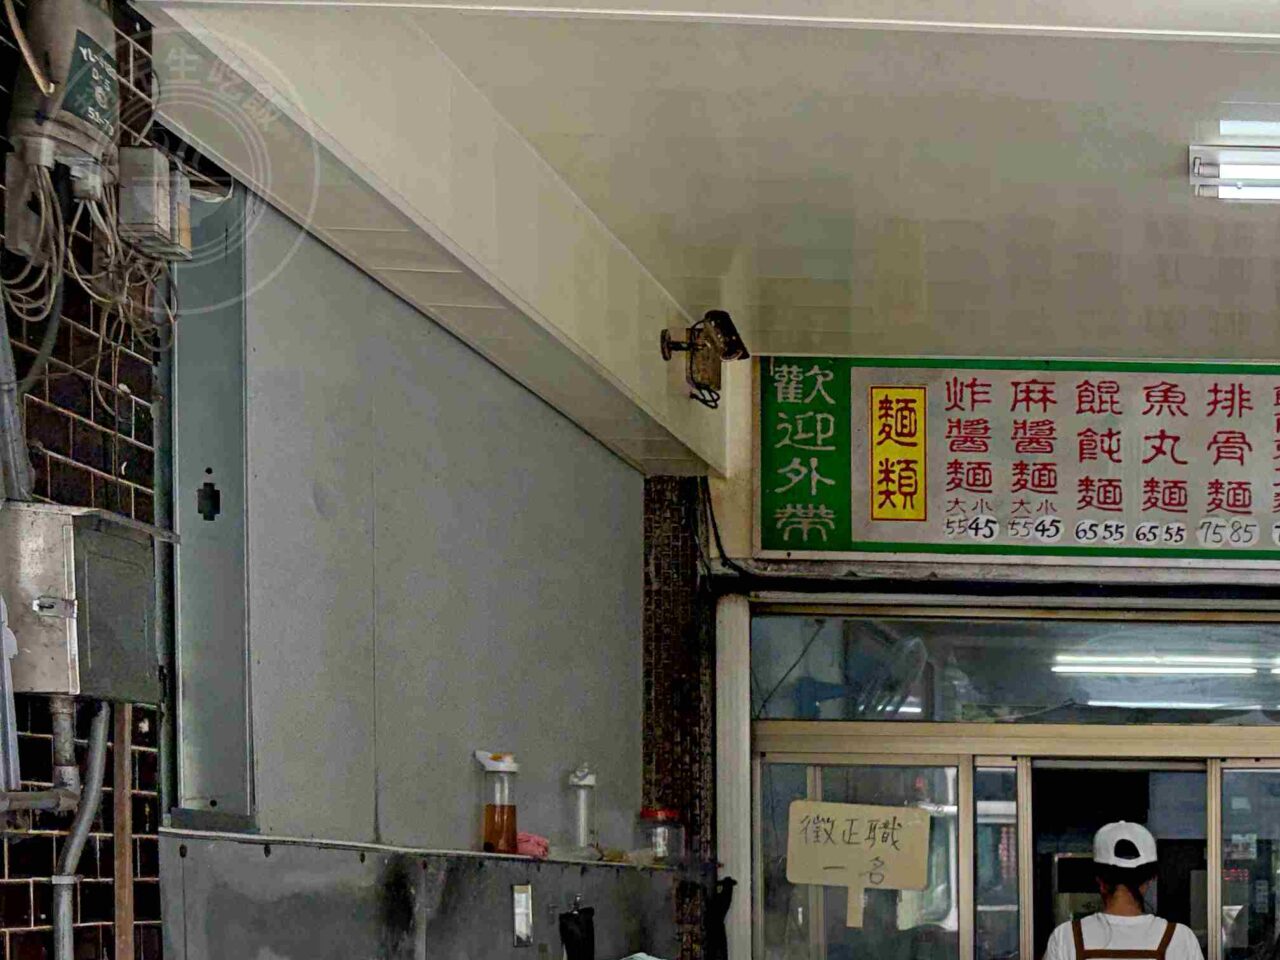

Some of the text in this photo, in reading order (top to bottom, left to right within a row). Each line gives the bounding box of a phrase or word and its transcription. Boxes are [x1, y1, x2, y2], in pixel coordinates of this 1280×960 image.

[945, 376, 992, 494] 炸醬麵
[1010, 378, 1058, 495] 麻醬麵
[1076, 379, 1123, 512] 餛飩麵
[1142, 381, 1189, 513] 魚丸麵
[1206, 382, 1254, 514] 排骨麵
[774, 364, 836, 542] 歡迎外帶
[877, 394, 918, 511] 麵類
[947, 498, 992, 514] 大 小
[1011, 499, 1058, 515] 大 小
[945, 516, 998, 538] 55 45
[1008, 515, 1062, 538] 55 45
[1075, 521, 1125, 540] 65 55
[1135, 524, 1185, 543] 65 55
[1199, 520, 1257, 544] 75 85
[801, 815, 902, 851] 徵正職
[822, 856, 885, 885] 一名
